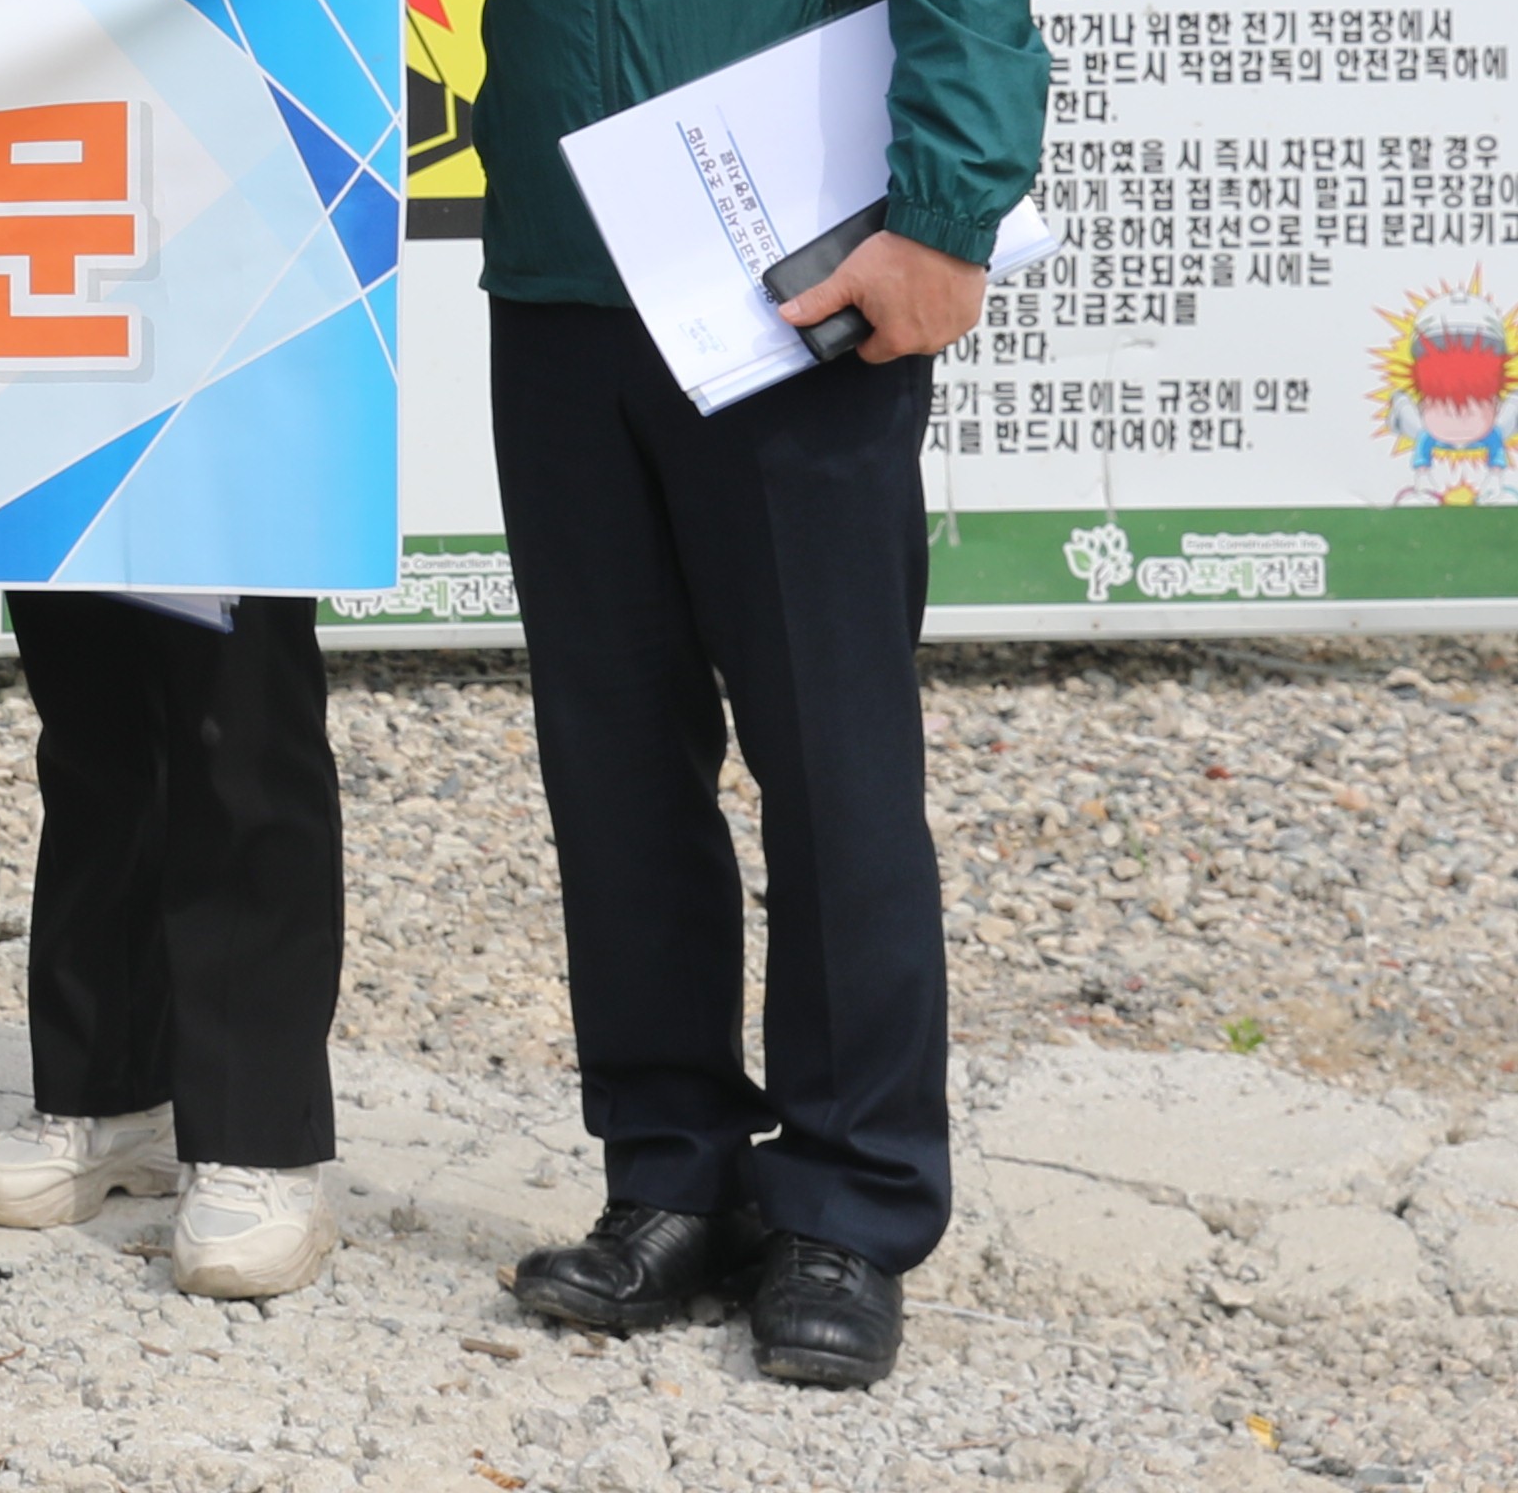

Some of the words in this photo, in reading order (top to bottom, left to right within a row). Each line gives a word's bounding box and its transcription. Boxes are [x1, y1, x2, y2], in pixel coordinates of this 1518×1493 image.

[1147, 12, 1232, 46] 위험한
[1243, 11, 1296, 45] 전기
[1310, 9, 1452, 45] 작업장에서
[1084, 51, 1166, 86] 반드시
[1180, 49, 1322, 84] 작업감독의
[1335, 47, 1507, 82] 안전감독하에
[1054, 90, 1116, 124] 한다.
[1177, 140, 1201, 173] 시
[1216, 139, 1268, 173] 즉시
[1281, 138, 1364, 172] 차단치
[1380, 137, 1433, 170] 못할
[1446, 135, 1498, 170] 경우
[1120, 178, 1174, 212] 직접
[1315, 176, 1368, 210] 말고
[1060, 216, 1174, 251] 사용하여
[1188, 214, 1301, 250] 전선으로
[1316, 214, 1368, 248] 부터
[1092, 253, 1234, 289] 중단되었을
[1247, 253, 1331, 286] 시에는
[1053, 292, 1196, 327] 긴급조치를
[992, 331, 1057, 365] 한다.
[993, 382, 1016, 417] 등
[1030, 381, 1144, 415] 회로에는
[1158, 380, 1241, 414] 규정에
[1254, 379, 1310, 413] 의한
[995, 419, 1078, 454] 반드시
[1091, 418, 1177, 452] 하여야
[1189, 418, 1253, 452] 한다.
[1142, 560, 1320, 595] (주)포레건설
